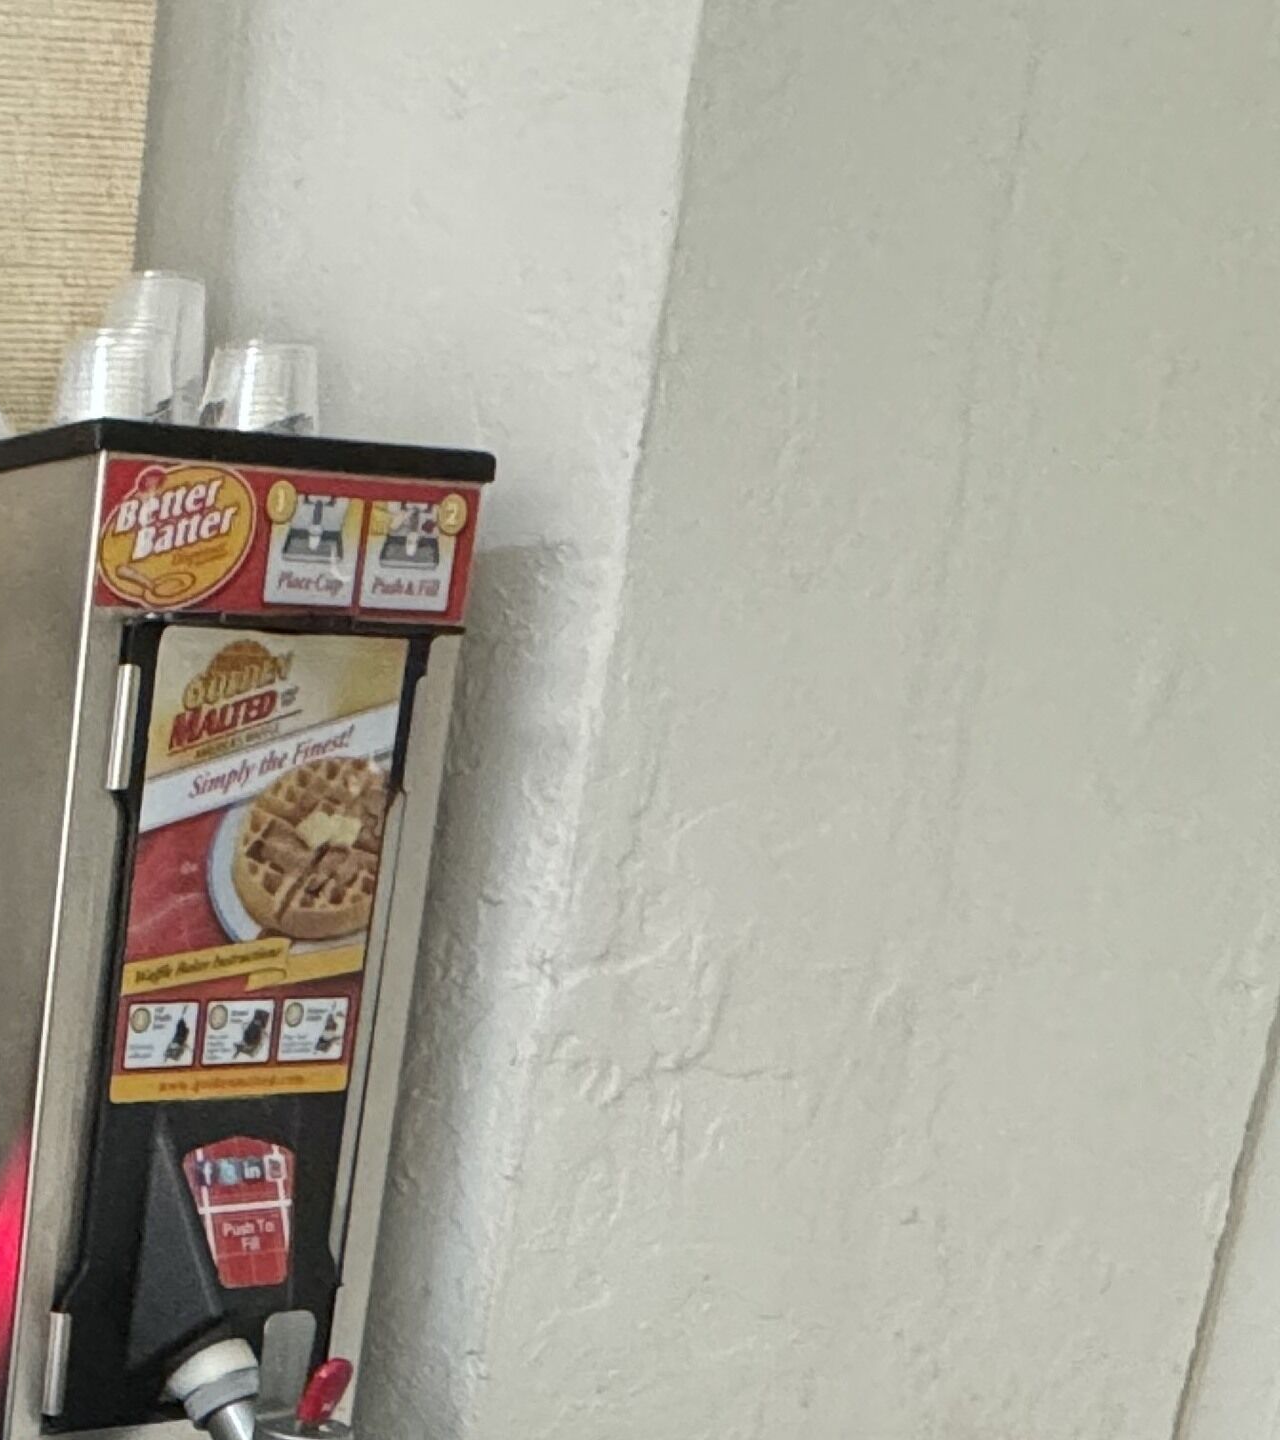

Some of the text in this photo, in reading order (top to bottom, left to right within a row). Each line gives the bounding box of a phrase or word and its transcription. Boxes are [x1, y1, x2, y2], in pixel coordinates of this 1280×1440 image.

[112, 477, 222, 535] Better
[444, 503, 458, 526] 2
[132, 505, 237, 560] Batter
[278, 572, 344, 597] Place Cup
[371, 575, 403, 595] Push
[418, 577, 440, 596] Fill
[182, 651, 294, 711] GOLDEN
[168, 690, 278, 752] MALTED
[188, 759, 256, 799] Simply
[258, 749, 289, 777] the
[292, 724, 356, 765] Finest!
[222, 1218, 276, 1238] Push To
[241, 1235, 261, 1256] Fill
